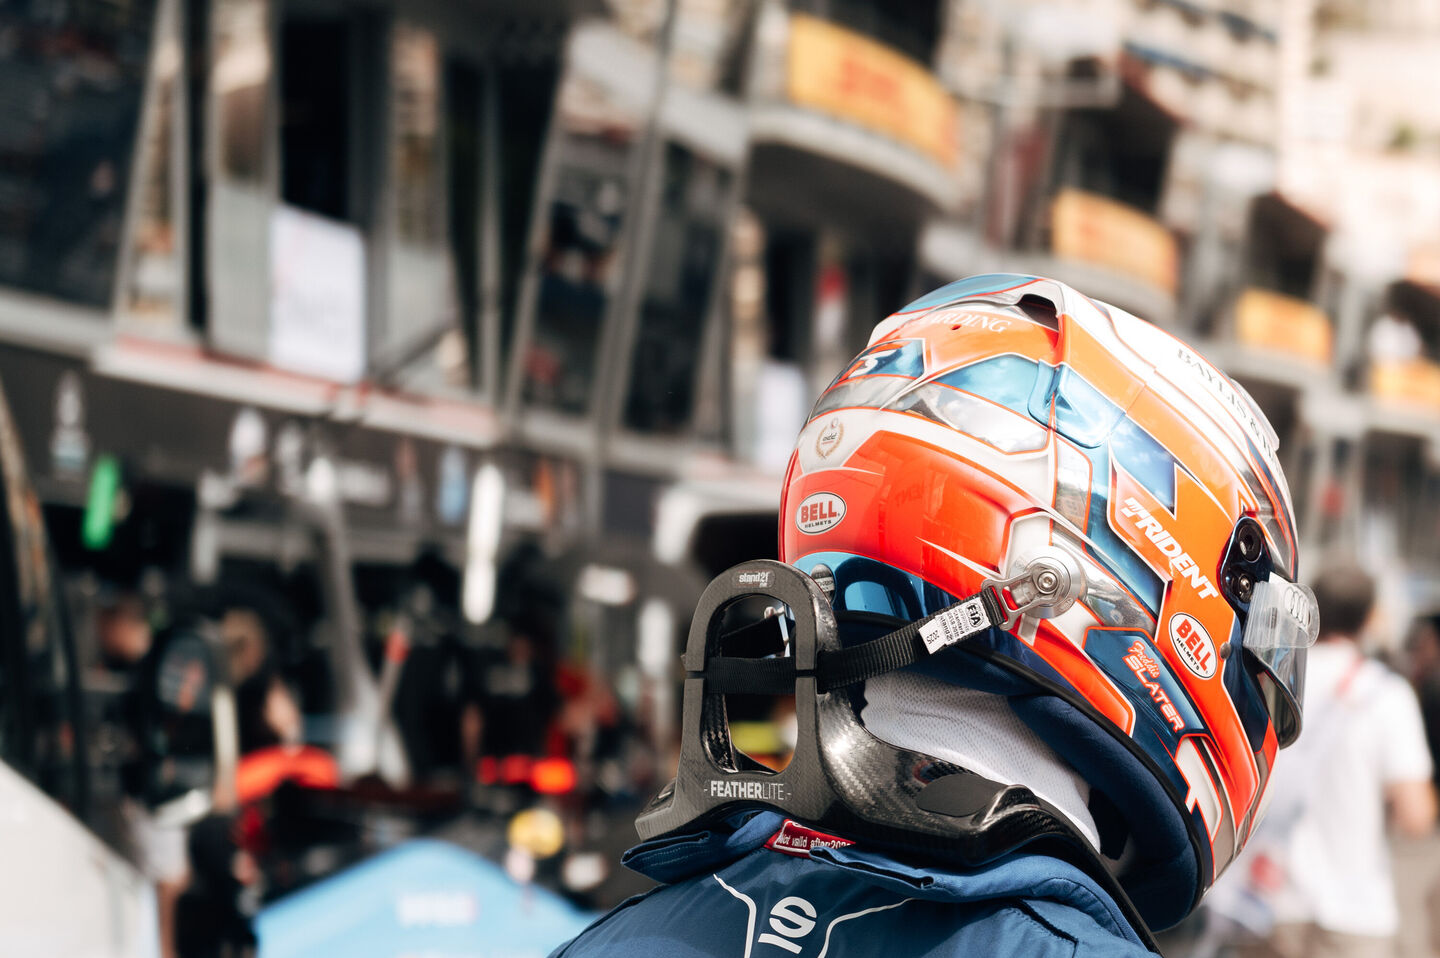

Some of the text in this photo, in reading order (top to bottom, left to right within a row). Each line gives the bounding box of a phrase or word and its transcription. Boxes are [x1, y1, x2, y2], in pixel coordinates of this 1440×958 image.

[800, 500, 838, 524] BELL
[804, 519, 832, 529] HELMETS
[1120, 496, 1219, 600] TRIDENT
[966, 604, 981, 626] FIA
[1176, 618, 1213, 672] BELL
[1176, 637, 1200, 671] HELMETS
[1123, 654, 1185, 732] SLATER
